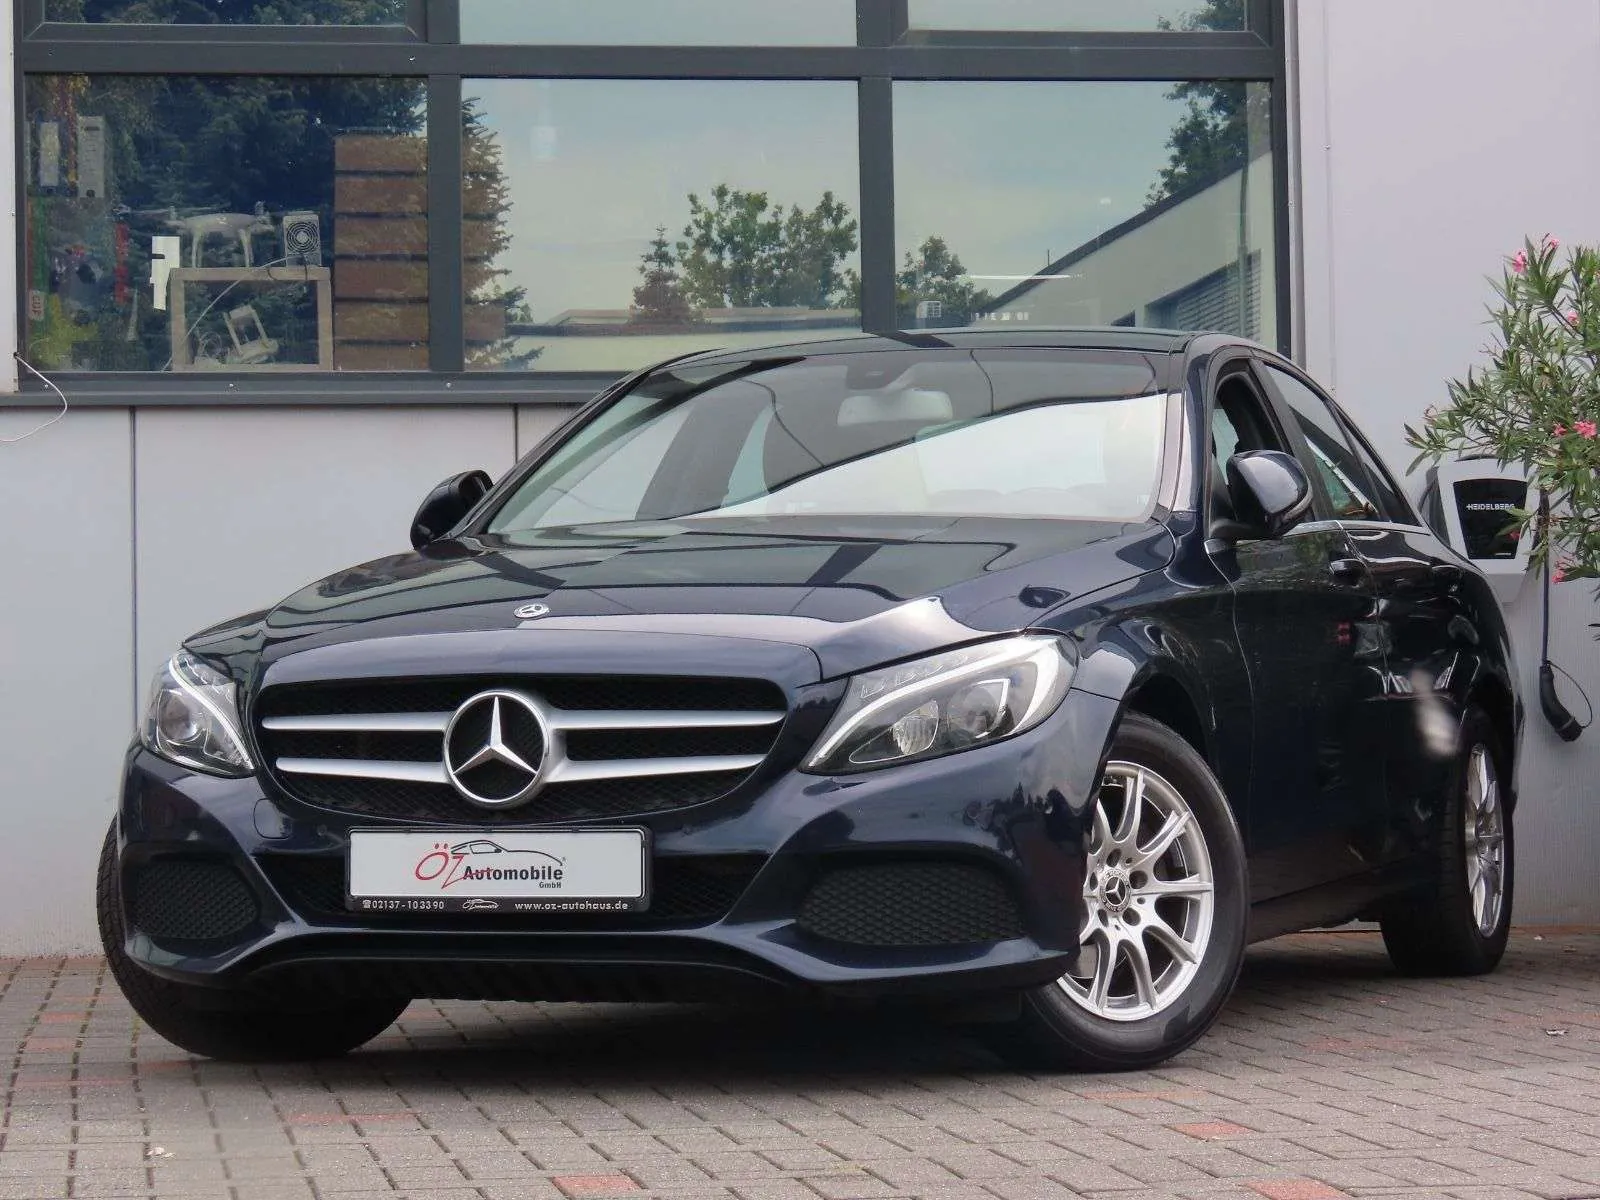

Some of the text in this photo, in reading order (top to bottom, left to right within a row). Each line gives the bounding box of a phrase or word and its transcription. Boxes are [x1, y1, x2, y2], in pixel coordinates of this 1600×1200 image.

[463, 865, 564, 880] Automobile
[539, 881, 562, 889] GmbH
[514, 900, 629, 910] www.oz-autohaus.de
